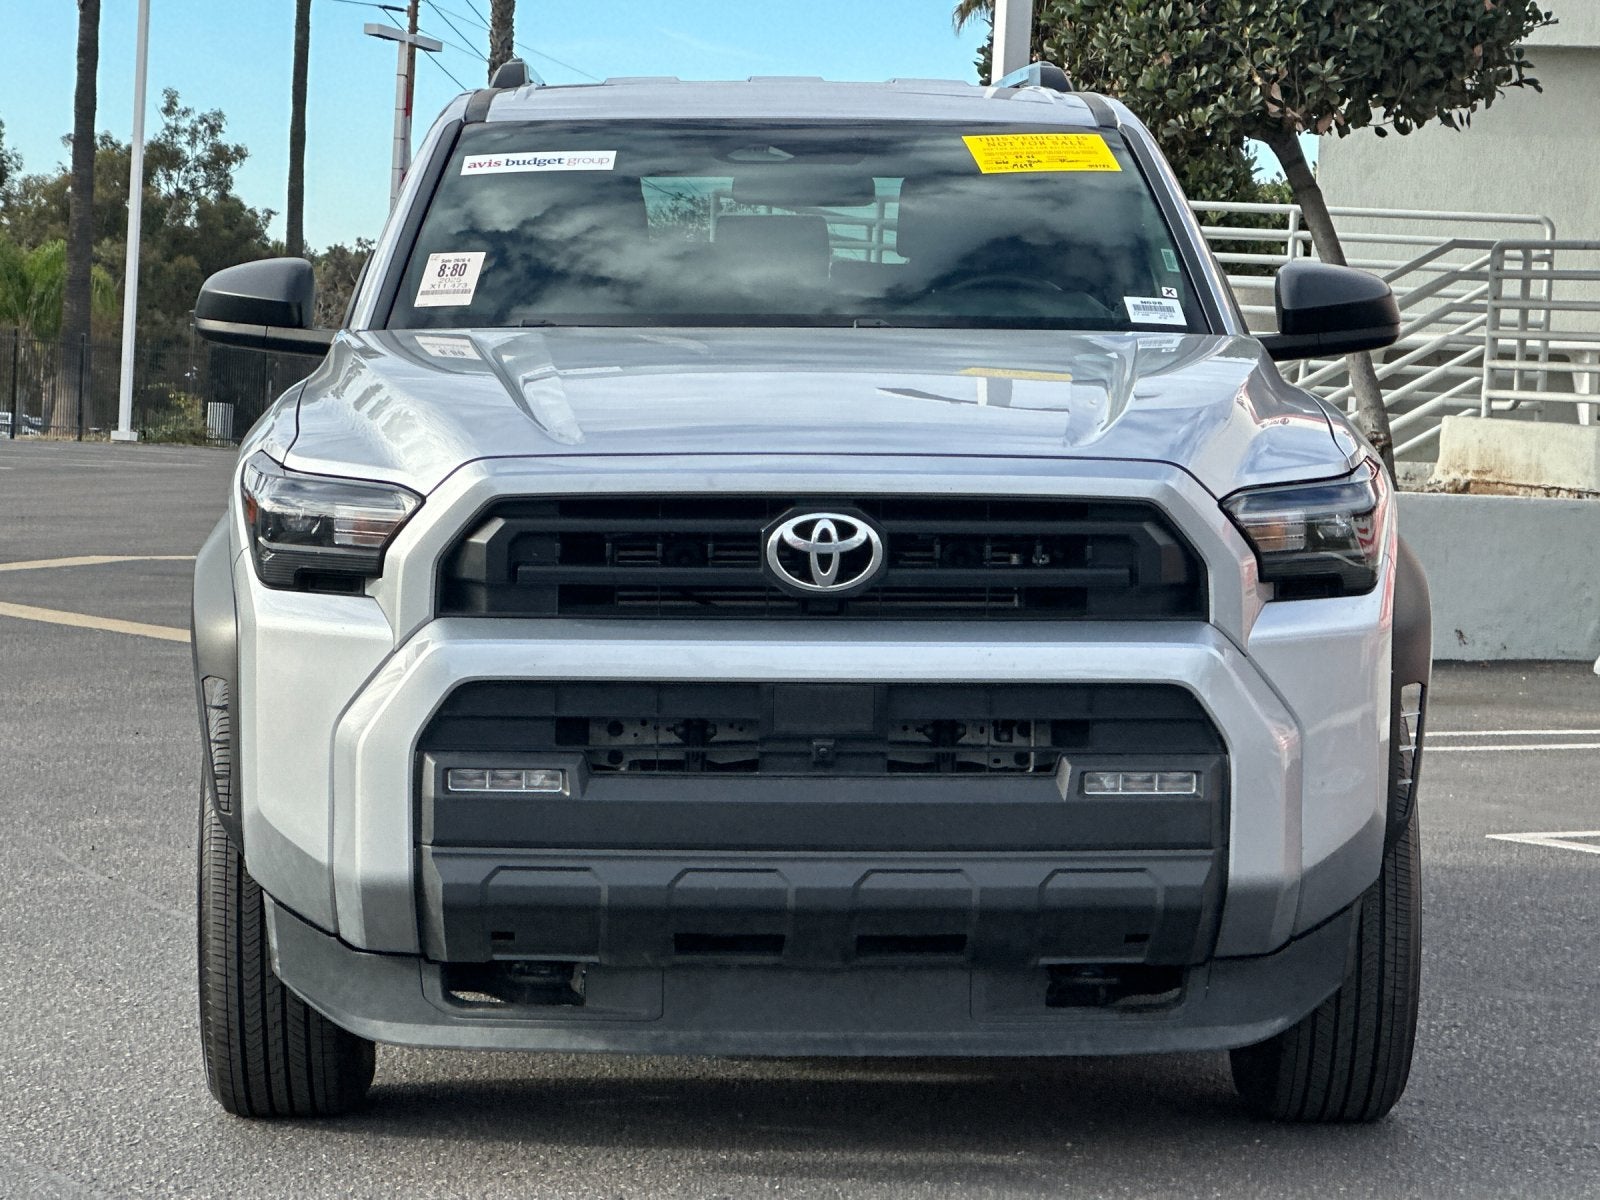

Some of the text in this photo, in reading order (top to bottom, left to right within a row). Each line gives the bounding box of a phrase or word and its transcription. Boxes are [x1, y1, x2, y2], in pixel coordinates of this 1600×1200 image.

[467, 156, 610, 169] avis budget group
[437, 263, 468, 278] 8:80
[1165, 288, 1175, 297] X
